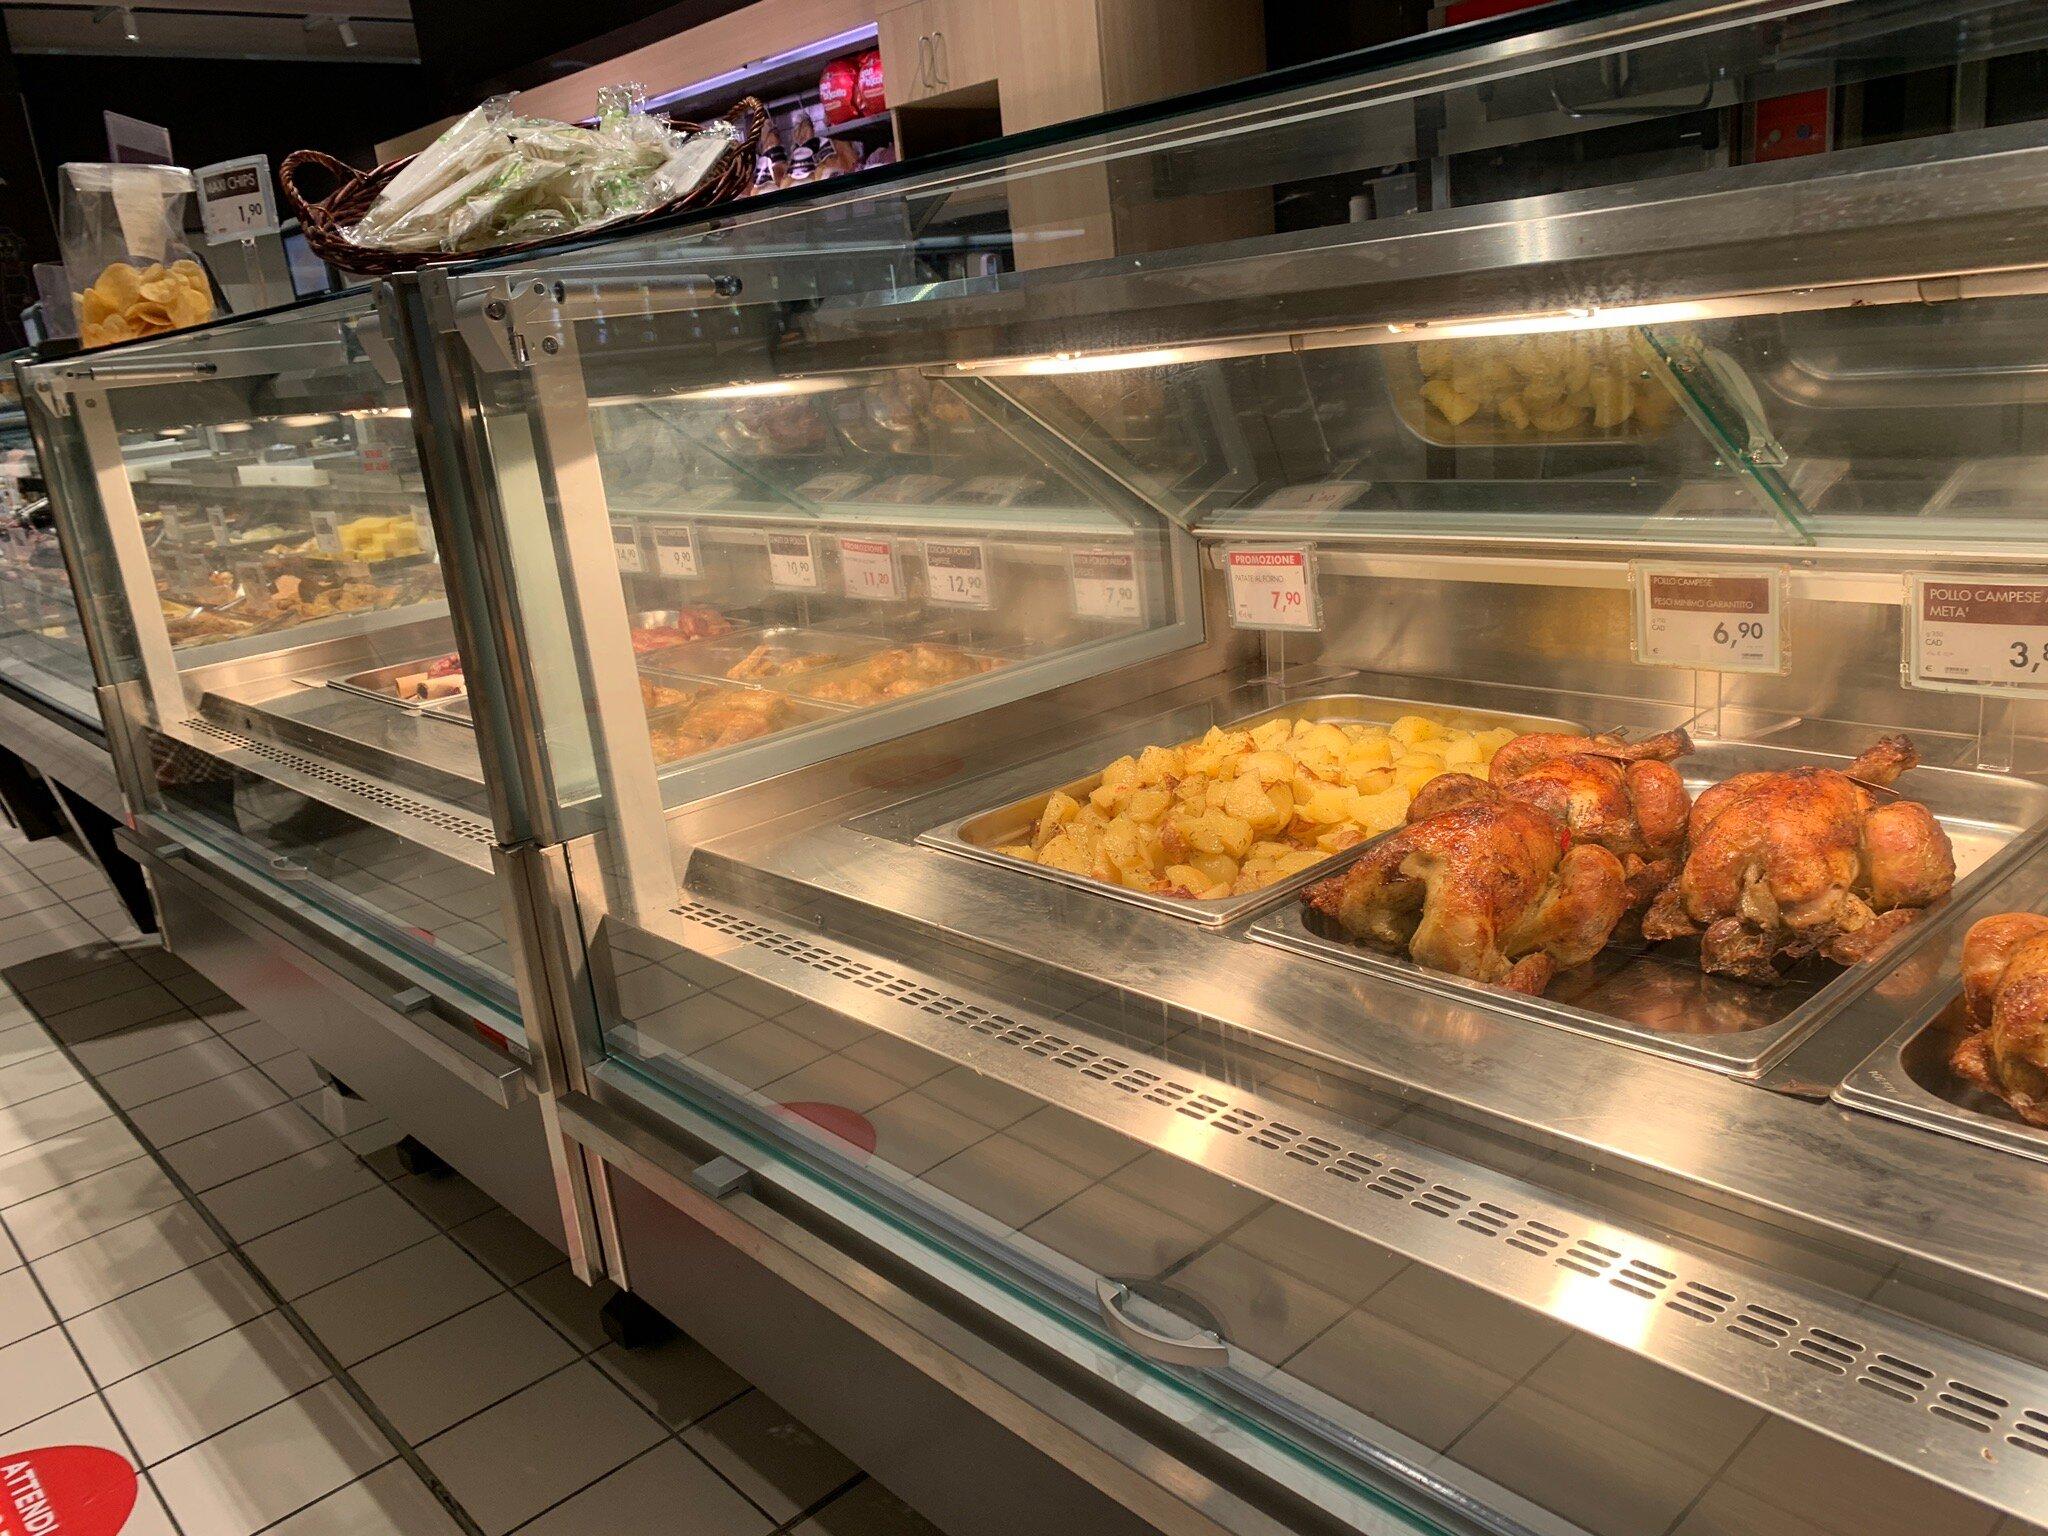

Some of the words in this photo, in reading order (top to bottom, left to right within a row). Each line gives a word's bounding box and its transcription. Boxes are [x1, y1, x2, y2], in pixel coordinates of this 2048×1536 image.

[227, 173, 256, 190] CHIPS
[238, 202, 262, 225] 1,90
[1235, 554, 1296, 566] PROMOZIONE
[947, 575, 982, 597] 12,90
[1653, 576, 1677, 586] POLLO
[1677, 578, 1713, 588] CAMPESE
[1270, 591, 1302, 613] 7,90
[1653, 597, 1672, 607] PESO
[1673, 598, 1704, 609] MINIMO
[1706, 599, 1754, 610] GARANTITO
[1930, 588, 1972, 602] POLLO
[1974, 590, 2042, 604] CAMPESE
[1651, 624, 1666, 632] CAD
[1712, 621, 1764, 650] 6,90
[1925, 638, 1943, 647] CAD
[0, 1460, 60, 1536] ATTENDI
